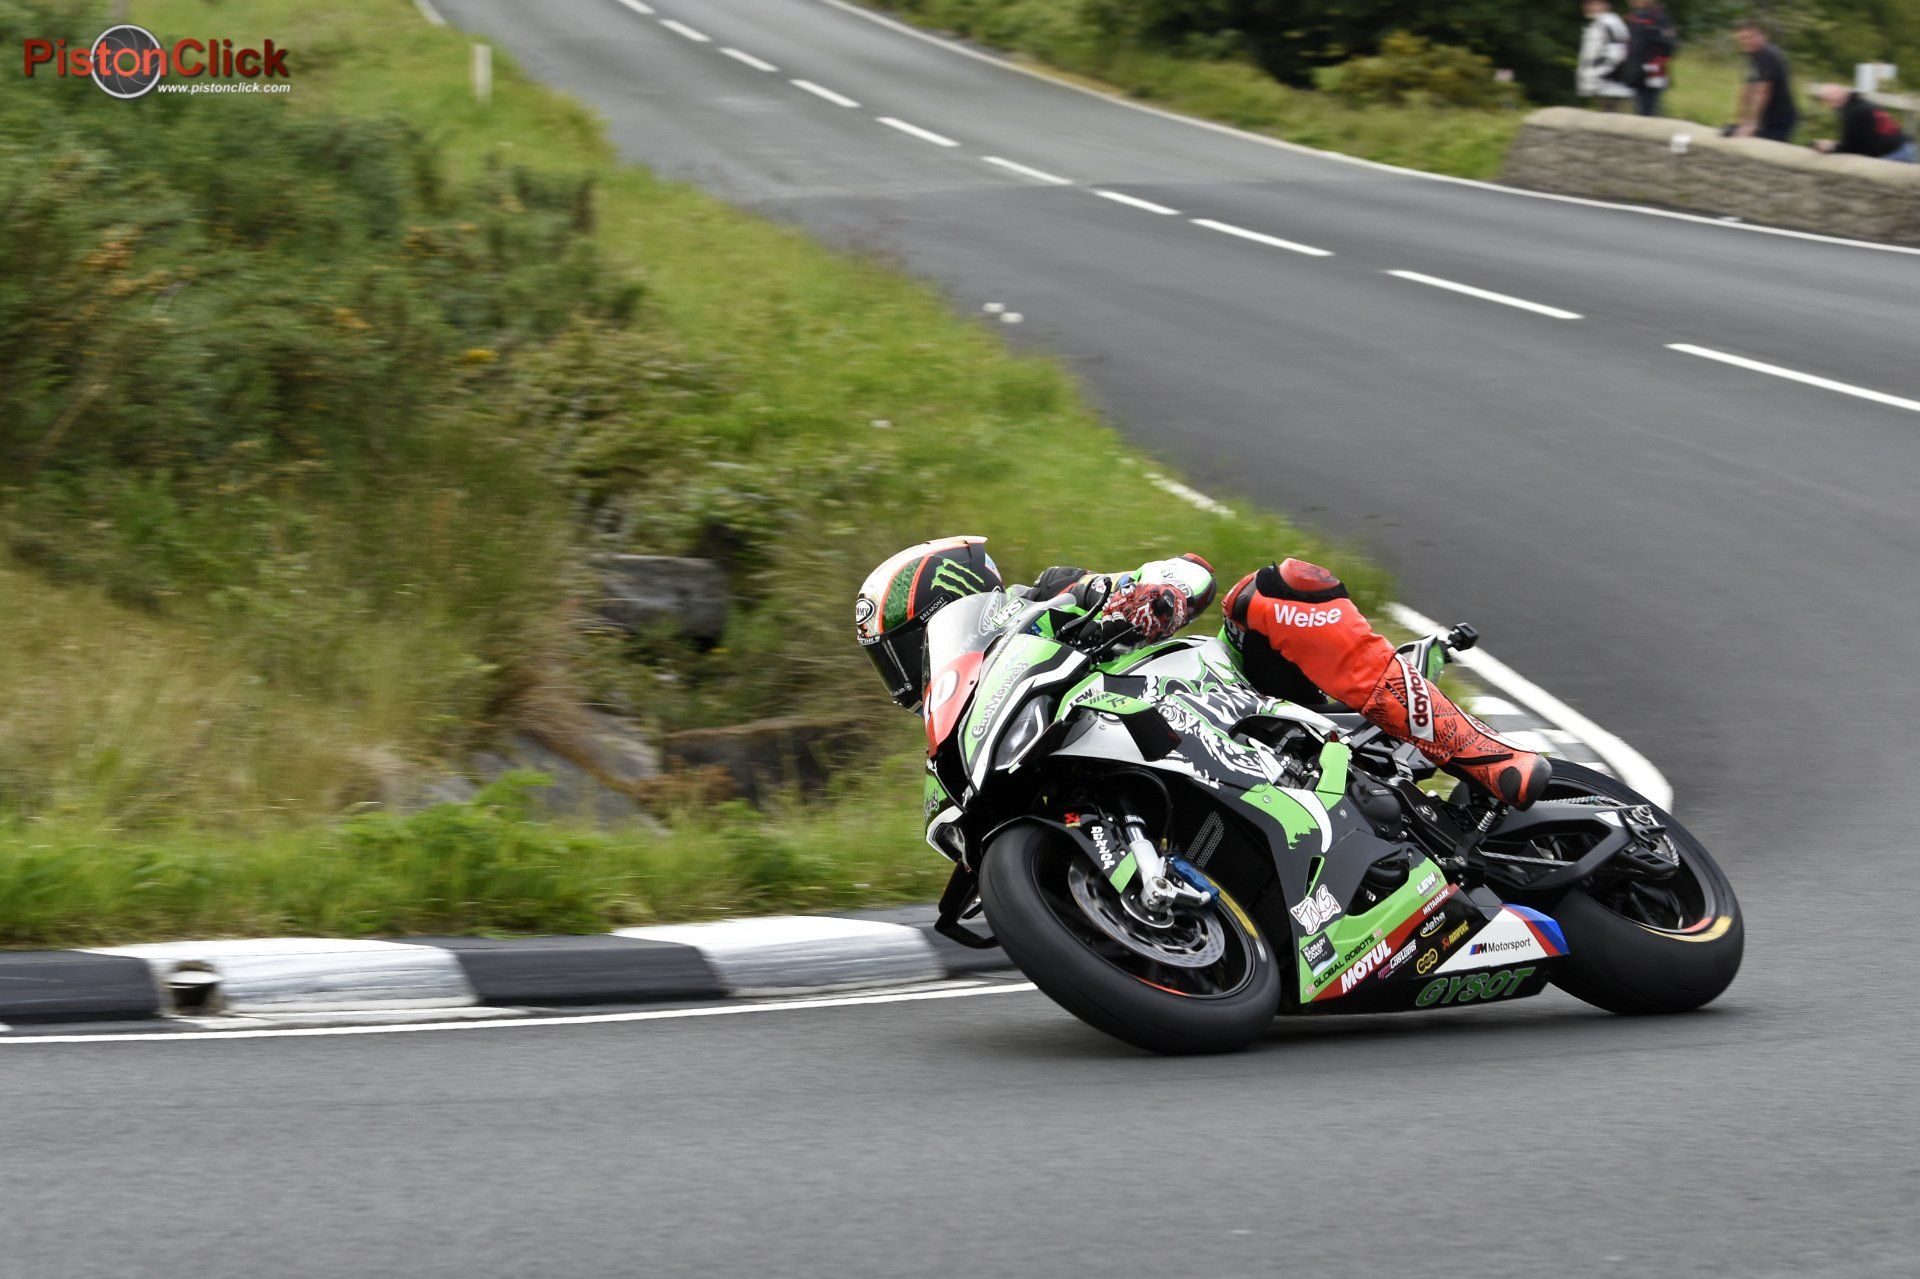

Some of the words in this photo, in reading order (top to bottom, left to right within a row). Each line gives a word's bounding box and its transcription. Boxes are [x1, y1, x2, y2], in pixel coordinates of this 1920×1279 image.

[919, 597, 946, 621] BREMONT
[1274, 603, 1342, 628] Weise
[1423, 911, 1446, 934] alpha
[1488, 938, 1531, 952] Motorsport
[1314, 961, 1344, 987] GLOBAL
[1344, 934, 1375, 963] ROBOTS
[1340, 939, 1391, 994] MOTUL
[1415, 967, 1536, 1007] GYSOT
